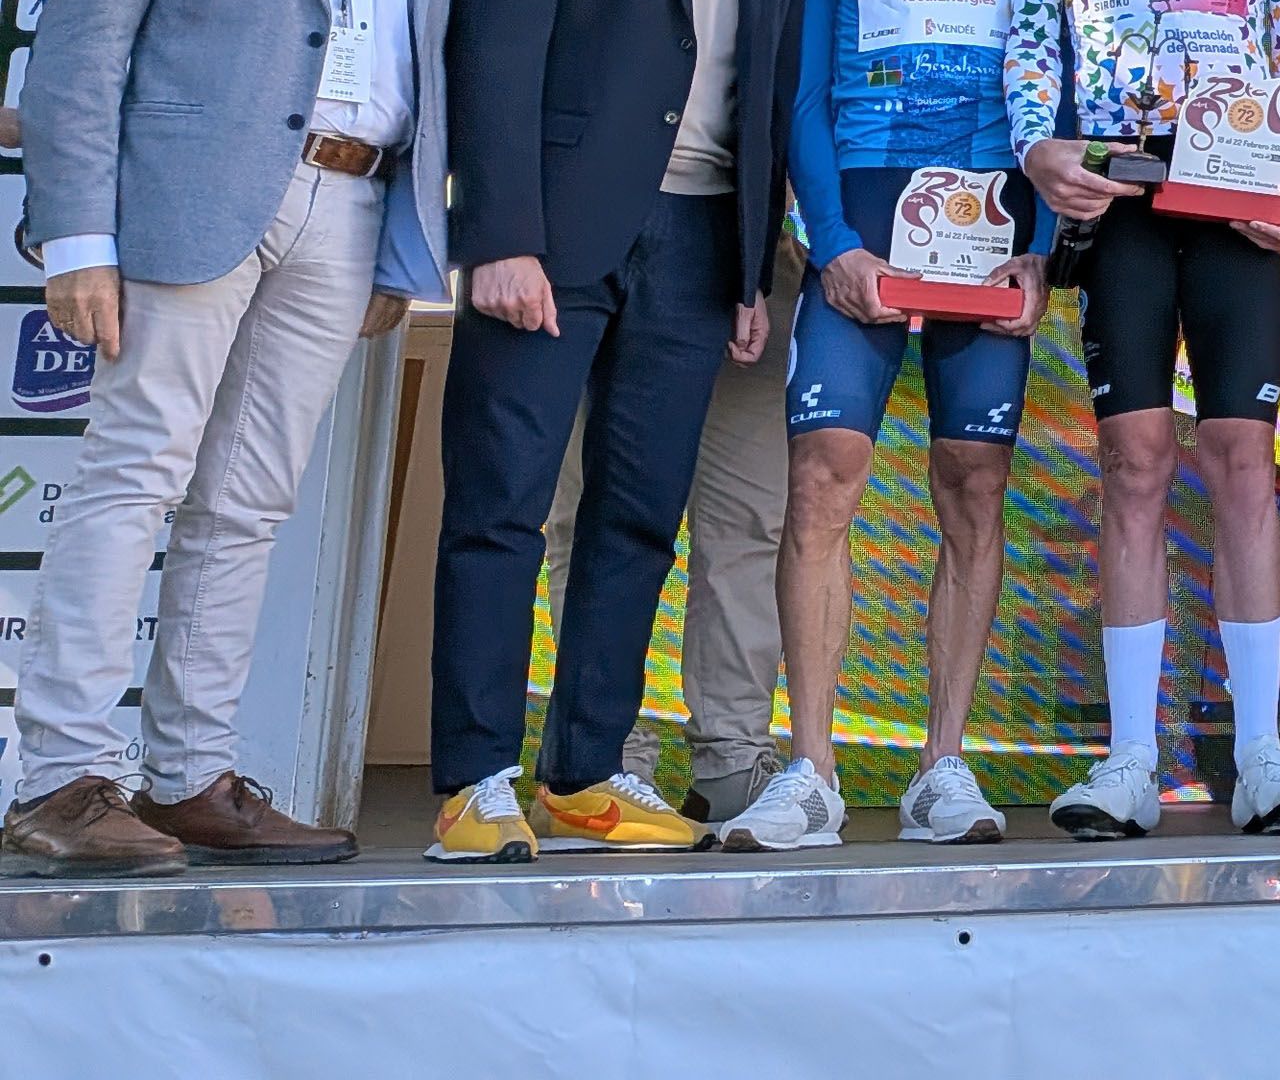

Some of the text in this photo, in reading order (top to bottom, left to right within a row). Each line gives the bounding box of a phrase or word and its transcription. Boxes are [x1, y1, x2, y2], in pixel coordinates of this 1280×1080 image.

[937, 23, 976, 35] VENDÉE
[1165, 28, 1234, 44] Diputación
[1167, 42, 1240, 55] de Granada
[1237, 108, 1255, 123] 72
[955, 202, 972, 216] 72
[791, 409, 841, 424] CUBE
[964, 423, 1014, 437] CUBE
